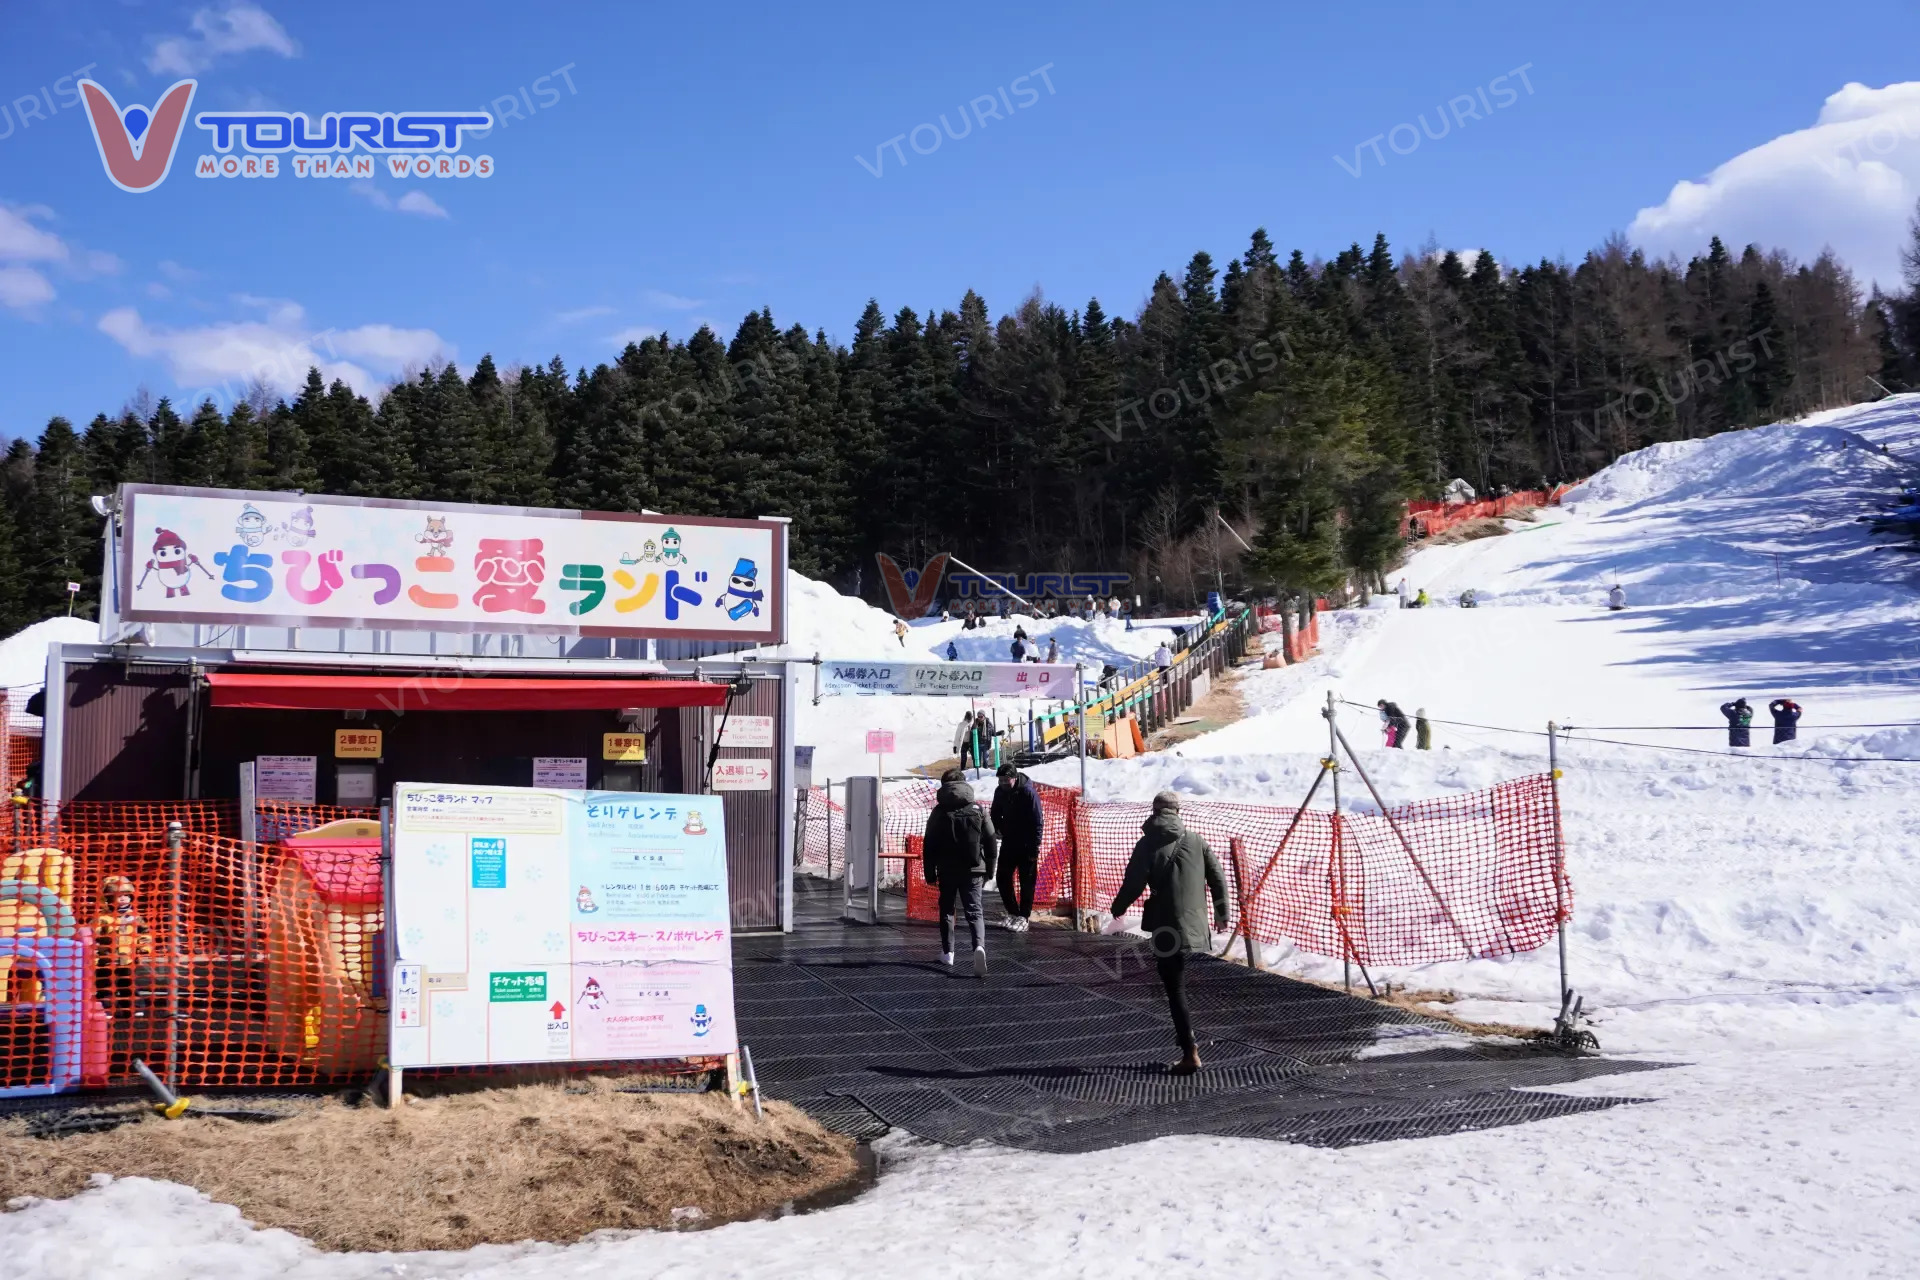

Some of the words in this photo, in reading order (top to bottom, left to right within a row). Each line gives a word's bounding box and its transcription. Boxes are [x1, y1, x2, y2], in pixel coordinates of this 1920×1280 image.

[214, 538, 709, 622] ちびっこ愛ランド
[833, 667, 891, 680] 入場券入口
[915, 669, 983, 681] リフト券入口
[340, 734, 378, 745] 2番窓口
[607, 737, 641, 747] 1番窓口
[715, 765, 754, 776] 入退場口
[471, 795, 493, 804] マップ
[492, 975, 545, 986] チケット売場
[399, 987, 418, 995] トイレ
[547, 1021, 569, 1030] 出入口
